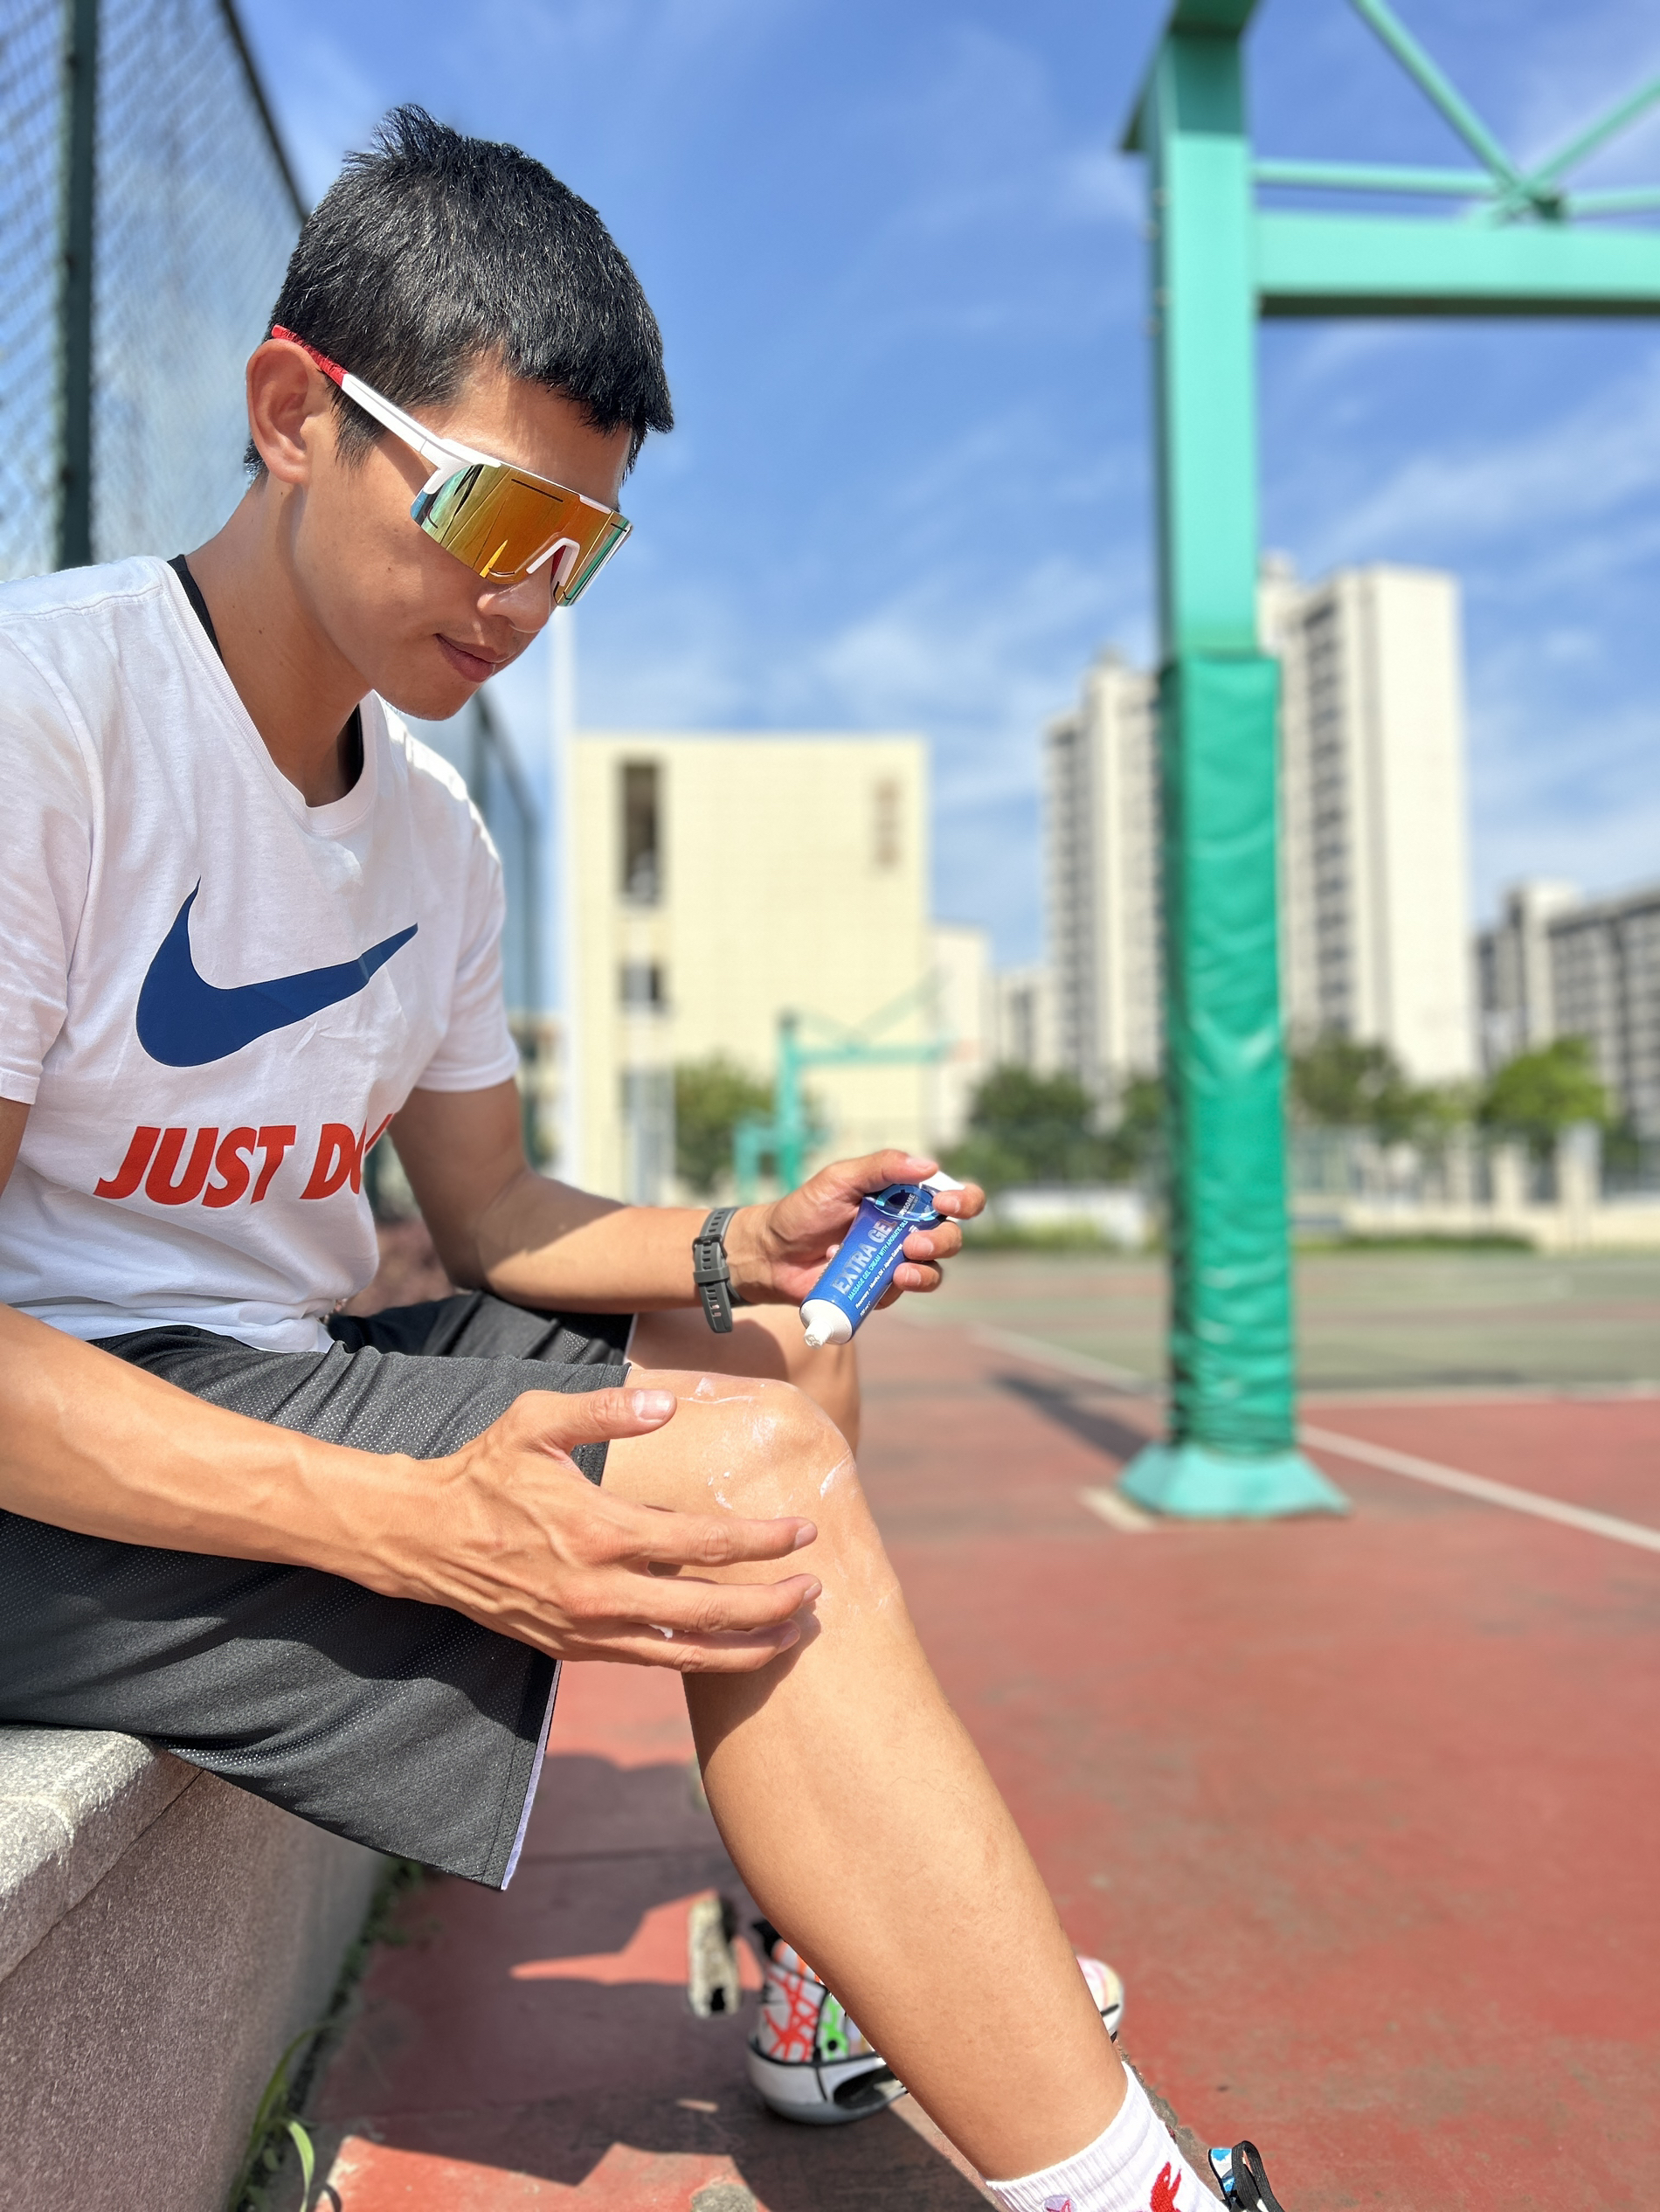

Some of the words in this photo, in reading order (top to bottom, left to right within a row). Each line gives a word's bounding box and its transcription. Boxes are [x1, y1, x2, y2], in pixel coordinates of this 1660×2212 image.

[92, 1123, 297, 1208] JUST
[832, 1243, 878, 1295] EXTRA
[868, 1219, 897, 1243] GEL
[847, 1278, 865, 1301] MASSAGE
[862, 1270, 871, 1280] GEL
[868, 1255, 882, 1271] CREAM
[878, 1244, 889, 1257] WITH
[886, 1227, 903, 1248] AROMATIC
